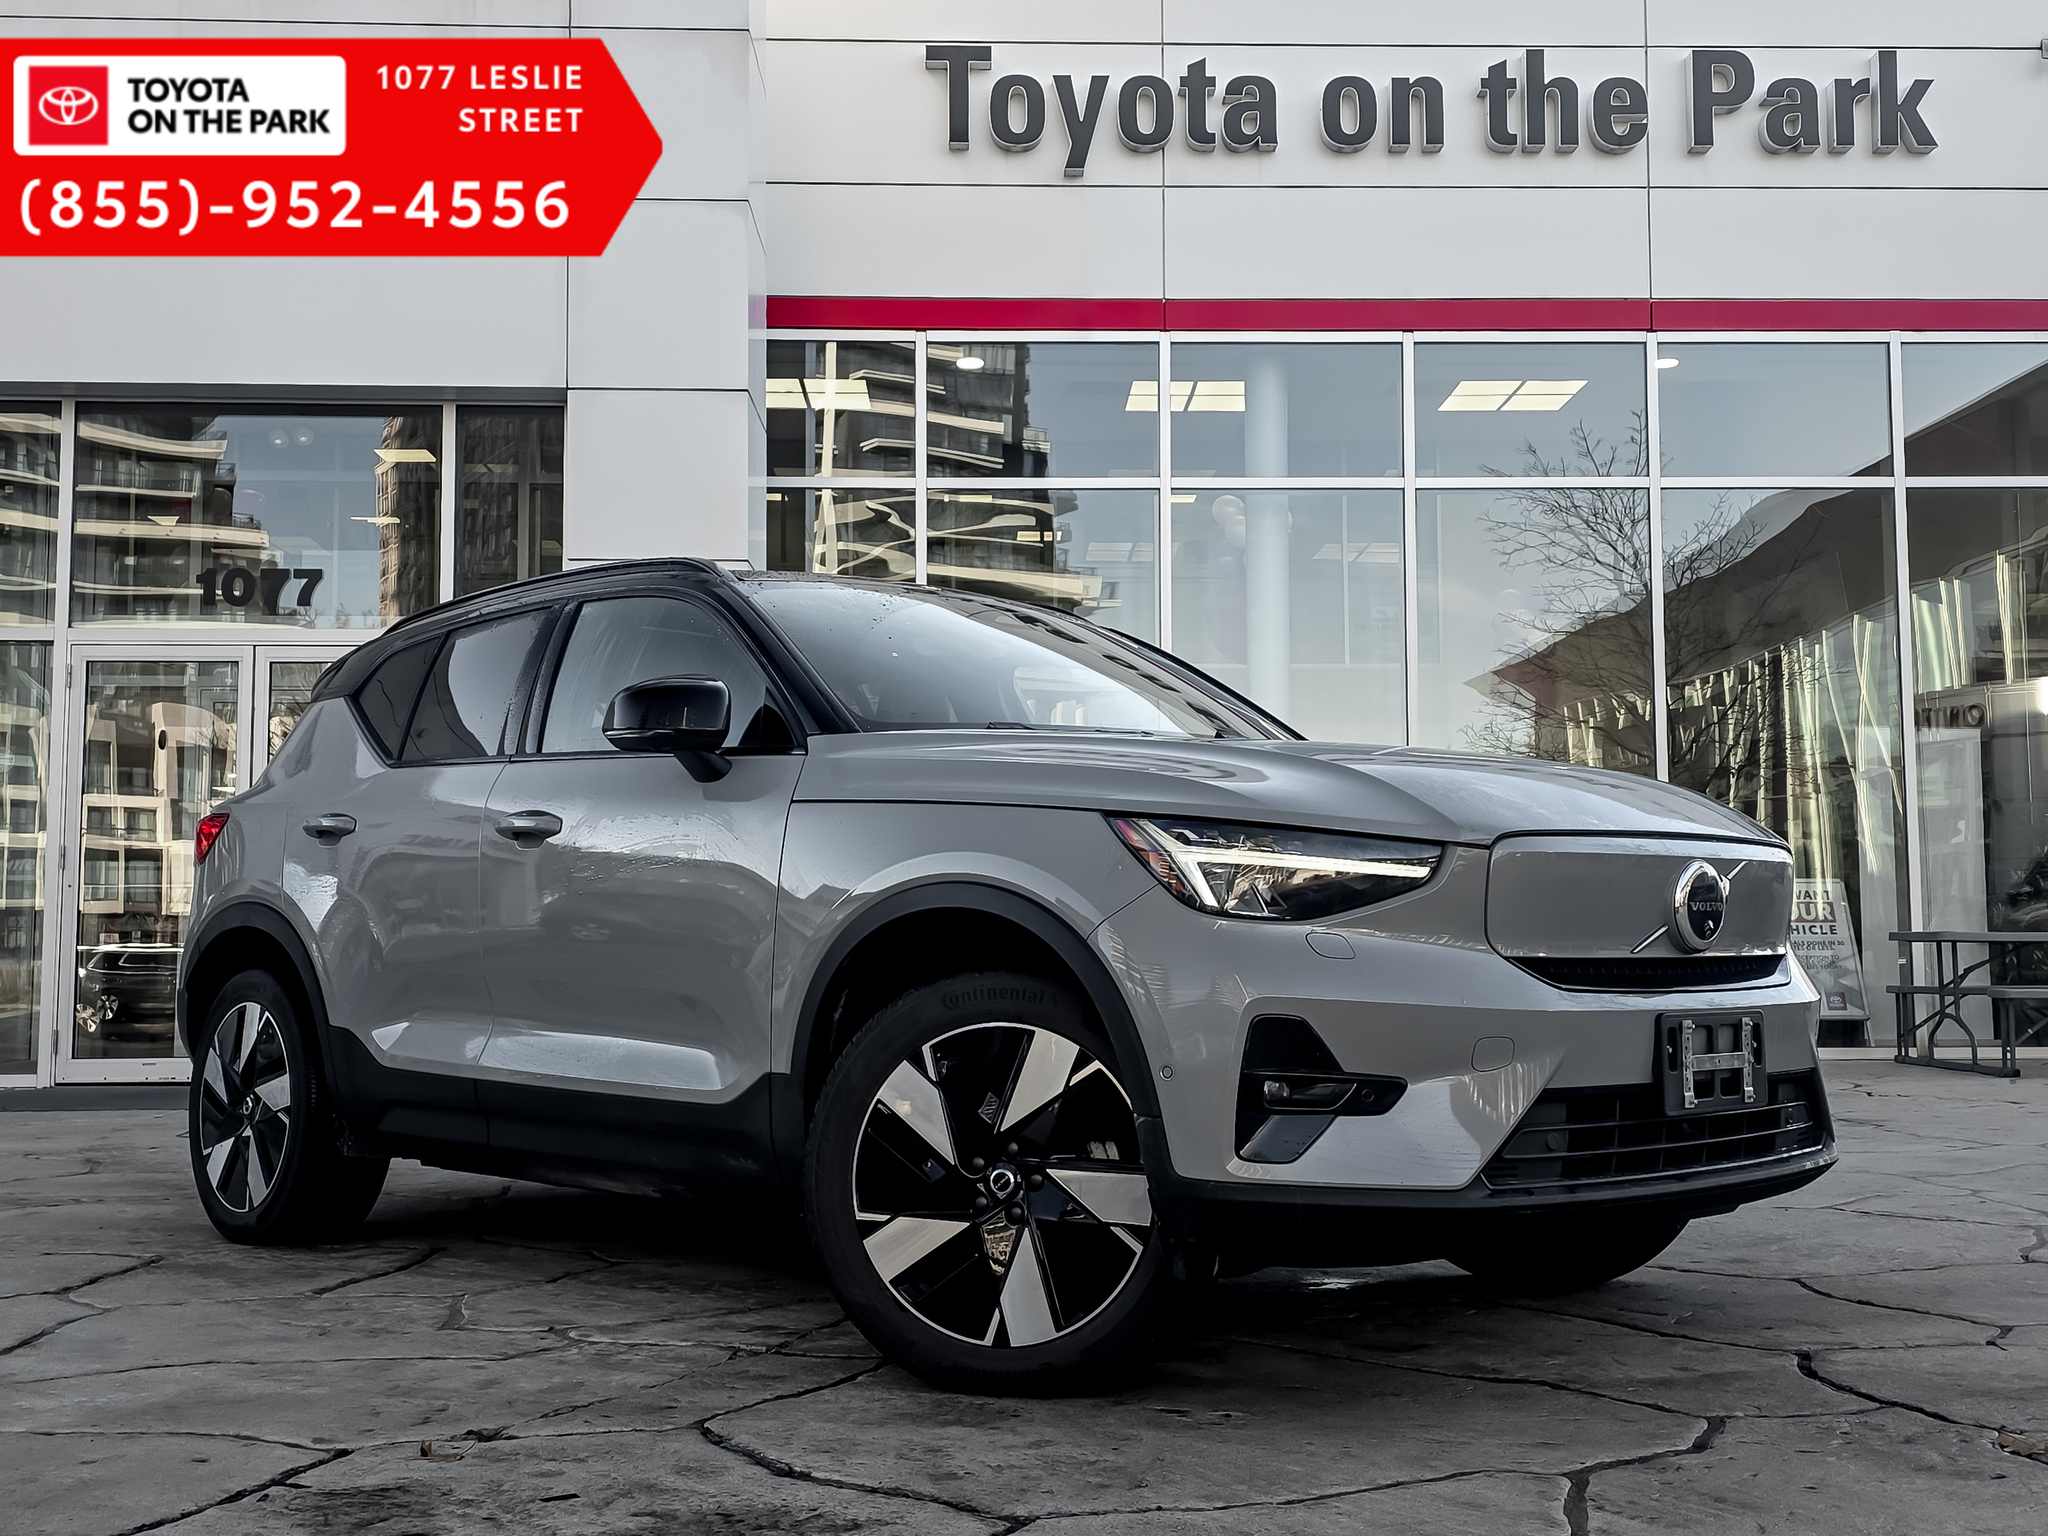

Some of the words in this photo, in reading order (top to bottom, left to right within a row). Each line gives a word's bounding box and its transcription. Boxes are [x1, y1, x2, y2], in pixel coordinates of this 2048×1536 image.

[924, 45, 1278, 177] Toyota
[1319, 75, 1445, 153] on
[1476, 48, 1649, 154] the
[1684, 49, 1938, 154] Park
[196, 567, 323, 607] 1077
[1690, 902, 1723, 911] VOLVO
[1791, 925, 1838, 935] HICLE
[942, 985, 1045, 1010] Continental
